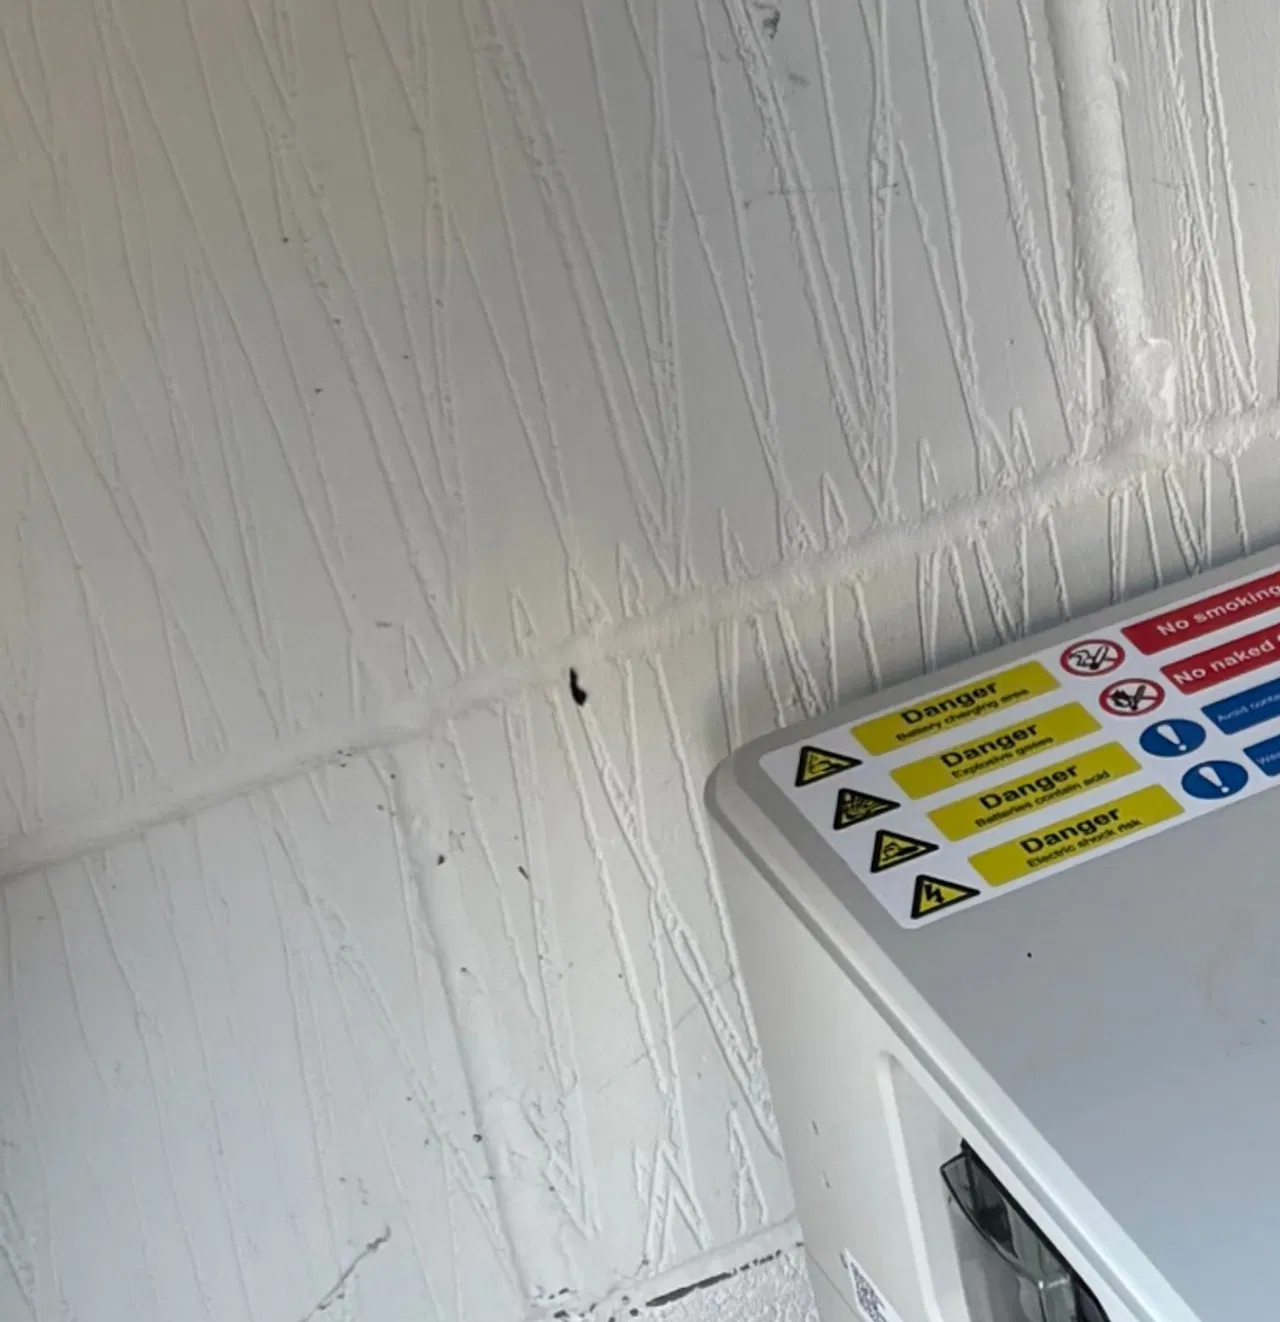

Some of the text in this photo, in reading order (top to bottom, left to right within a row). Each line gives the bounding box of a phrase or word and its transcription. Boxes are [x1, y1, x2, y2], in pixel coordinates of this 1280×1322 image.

[1156, 619, 1189, 636] No
[1172, 667, 1206, 685] No
[1209, 640, 1275, 673] naked
[901, 682, 997, 724] Danger
[940, 724, 1037, 768] Danger
[979, 765, 1077, 810] Danger
[1020, 808, 1120, 854] Danger
[1026, 819, 1142, 867] Electric shock risk
